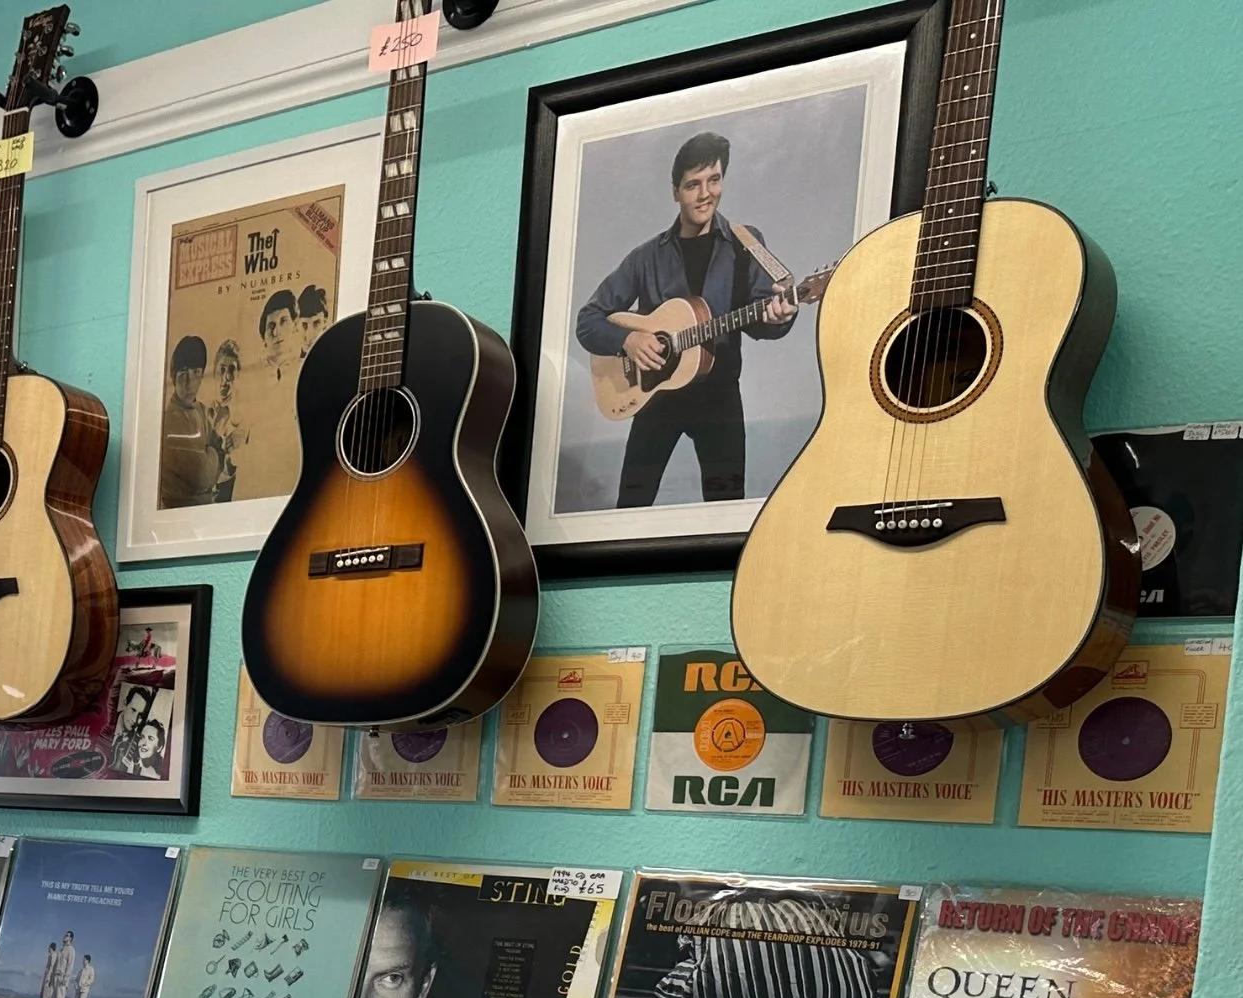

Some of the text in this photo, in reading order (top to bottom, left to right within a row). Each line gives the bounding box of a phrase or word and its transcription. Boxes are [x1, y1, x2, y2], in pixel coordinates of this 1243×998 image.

[378, 32, 424, 57] £250
[248, 231, 274, 252] The
[179, 254, 233, 284] EXPRESS
[244, 253, 278, 275] Who
[217, 270, 302, 295] BY NUMBERS
[44, 724, 90, 738] LES PAUL
[33, 737, 92, 750] MARY FORD
[529, 774, 579, 790] MASTER'S
[671, 775, 776, 807] RCA
[869, 780, 930, 800] MASTER'S
[1072, 789, 1143, 809] MASTER'S
[231, 865, 326, 883] THE VERY BEST OF
[553, 870, 571, 878] 1994
[41, 879, 135, 896] THIS IS MY TRUTH TELL ME YOURS
[224, 878, 324, 908] SCOUTING
[579, 880, 605, 894] £65
[47, 892, 123, 907] MANIC STREET PREACHERS
[219, 901, 318, 932] FOR GIRLS
[938, 899, 1025, 934] RETURN
[1028, 904, 1058, 936] OF
[1062, 907, 1105, 940] THE
[646, 923, 880, 950] the best of JULIAN COPE and THE TEARDROP EXPLODES 1979-91
[558, 944, 582, 995] GOLD
